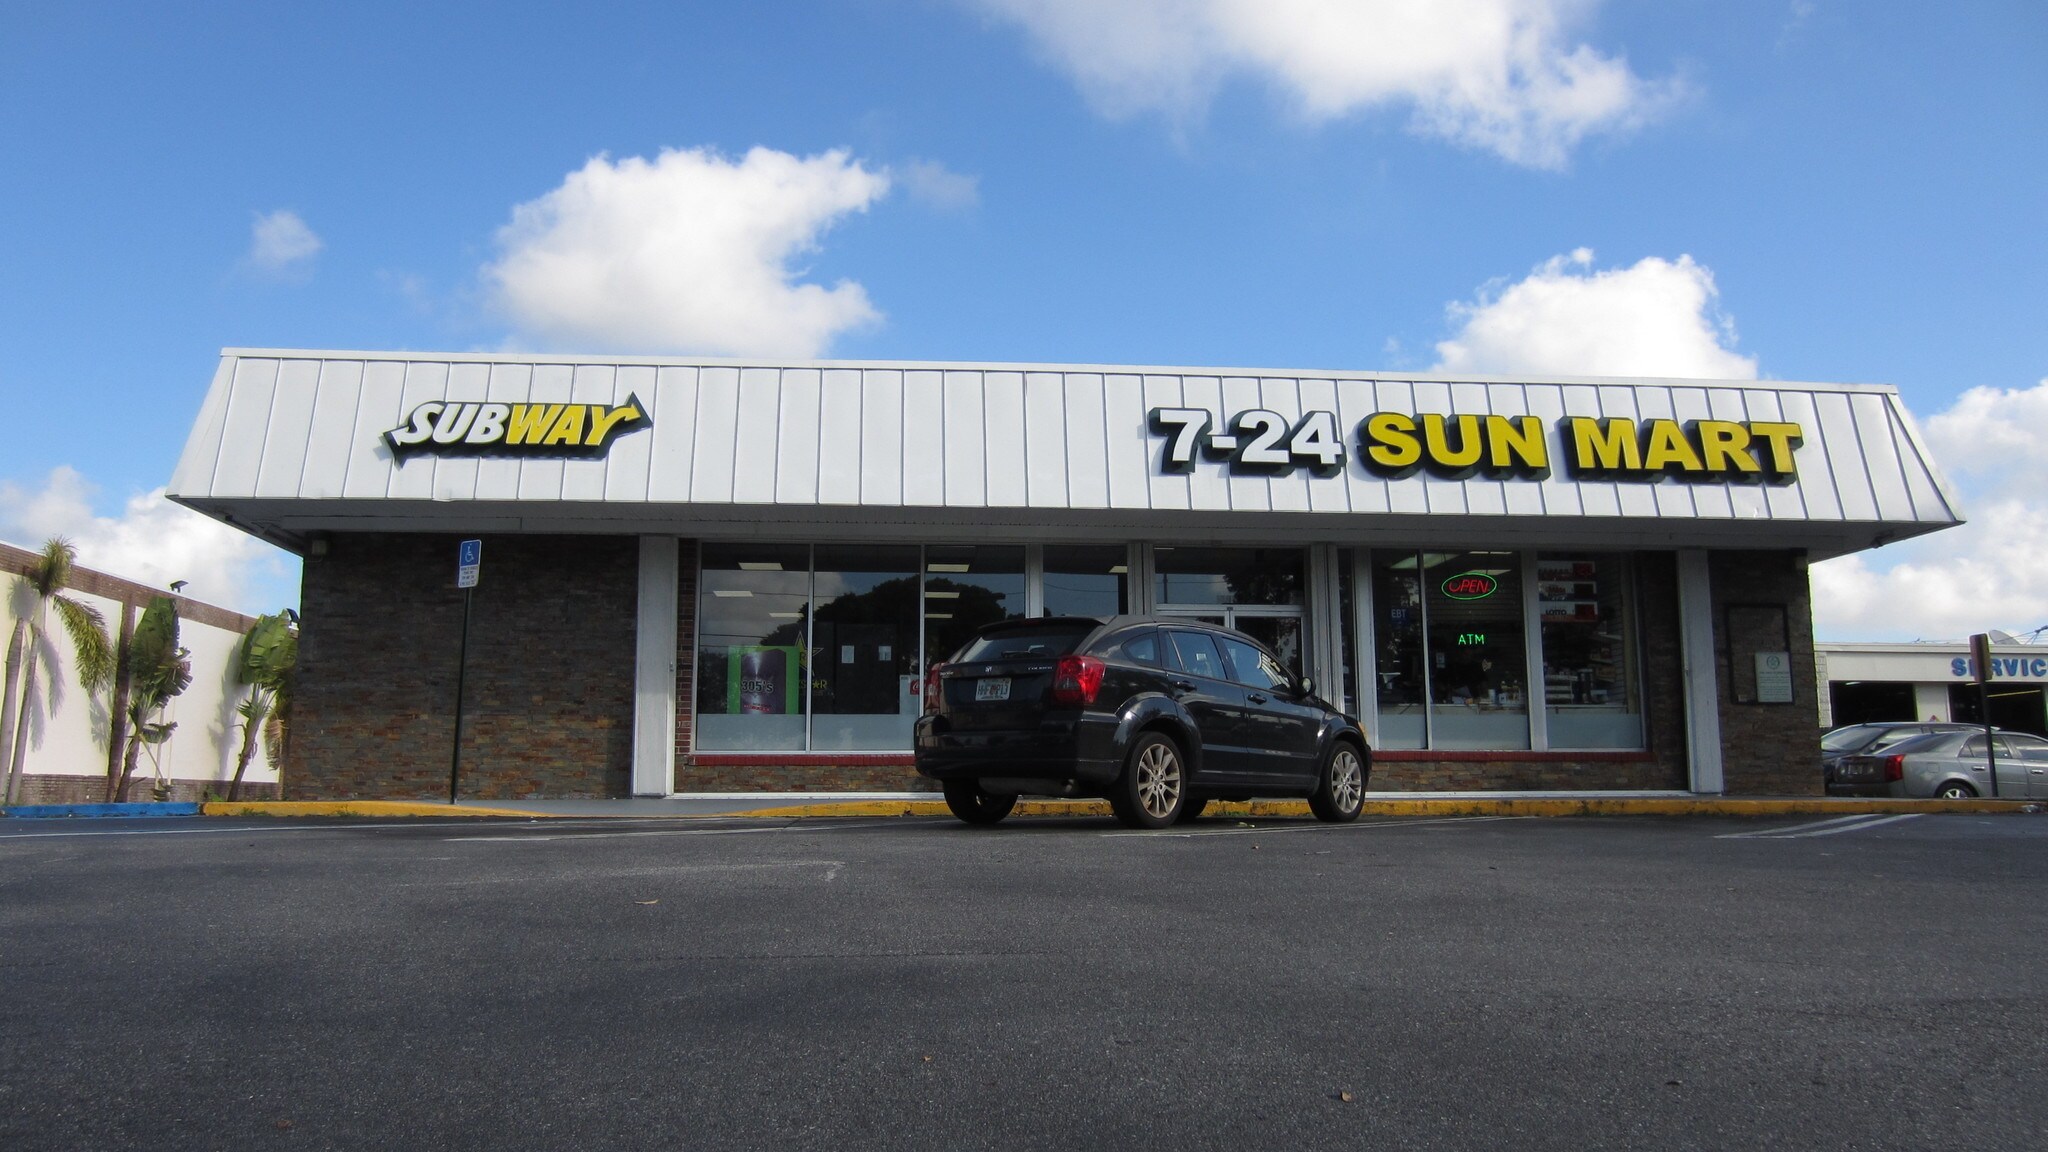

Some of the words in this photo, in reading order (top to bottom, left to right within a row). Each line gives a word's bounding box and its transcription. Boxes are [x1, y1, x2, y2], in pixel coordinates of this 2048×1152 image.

[391, 402, 642, 446] SUBWAY
[1160, 409, 1343, 465] 7-24
[1368, 412, 1547, 468] SUN
[1571, 418, 1802, 473] MART
[1448, 579, 1489, 593] OPEN
[1391, 608, 1407, 619] EBT
[1458, 633, 1485, 646] ATM
[741, 679, 774, 694] 305's
